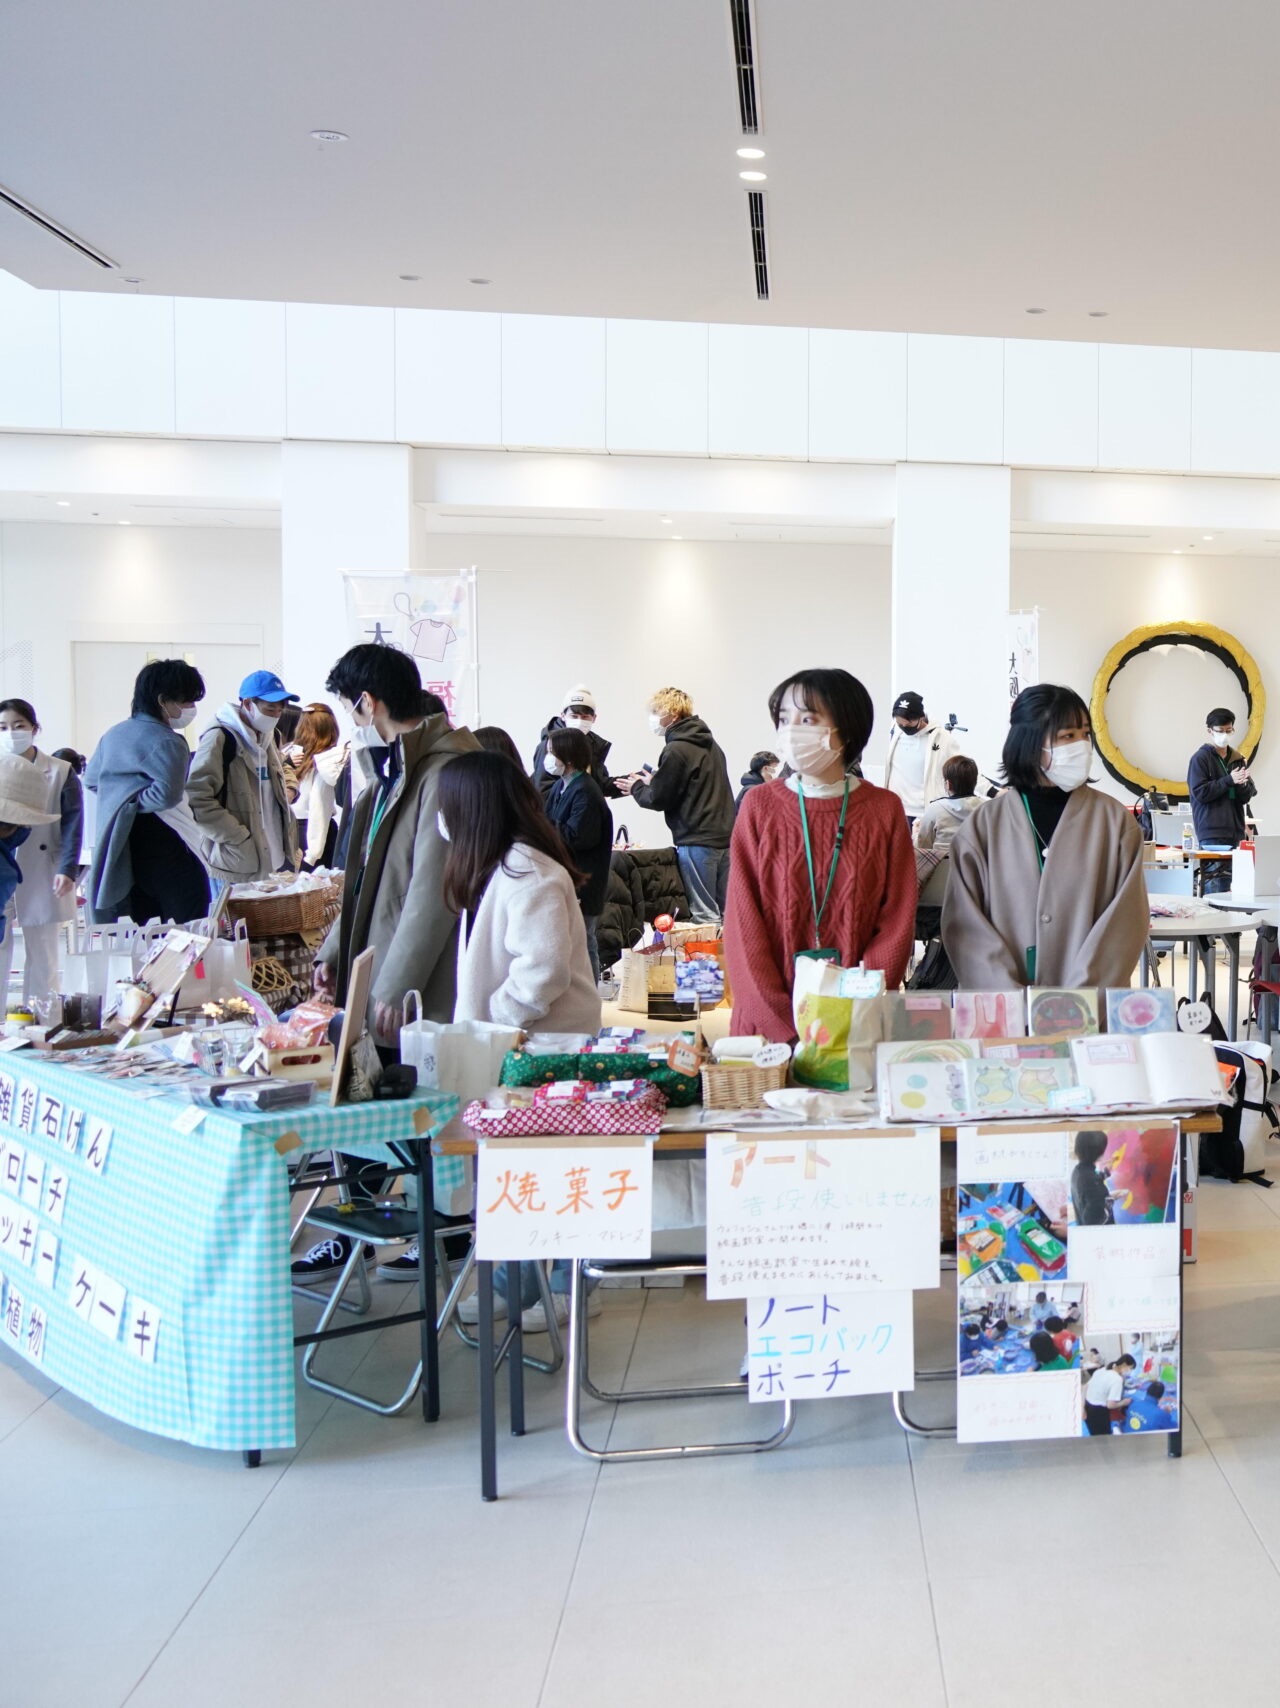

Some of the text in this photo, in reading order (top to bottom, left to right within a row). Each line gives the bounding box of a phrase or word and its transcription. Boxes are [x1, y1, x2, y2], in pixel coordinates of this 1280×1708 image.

[0, 1142, 62, 1212] ローチ
[721, 1139, 831, 1188] アート
[486, 1166, 639, 1215] 焼菓子
[6, 1290, 43, 1357] 植物
[76, 1270, 151, 1357] ケーキ
[757, 1294, 841, 1329] ノート
[756, 1358, 851, 1395] ポーチ
